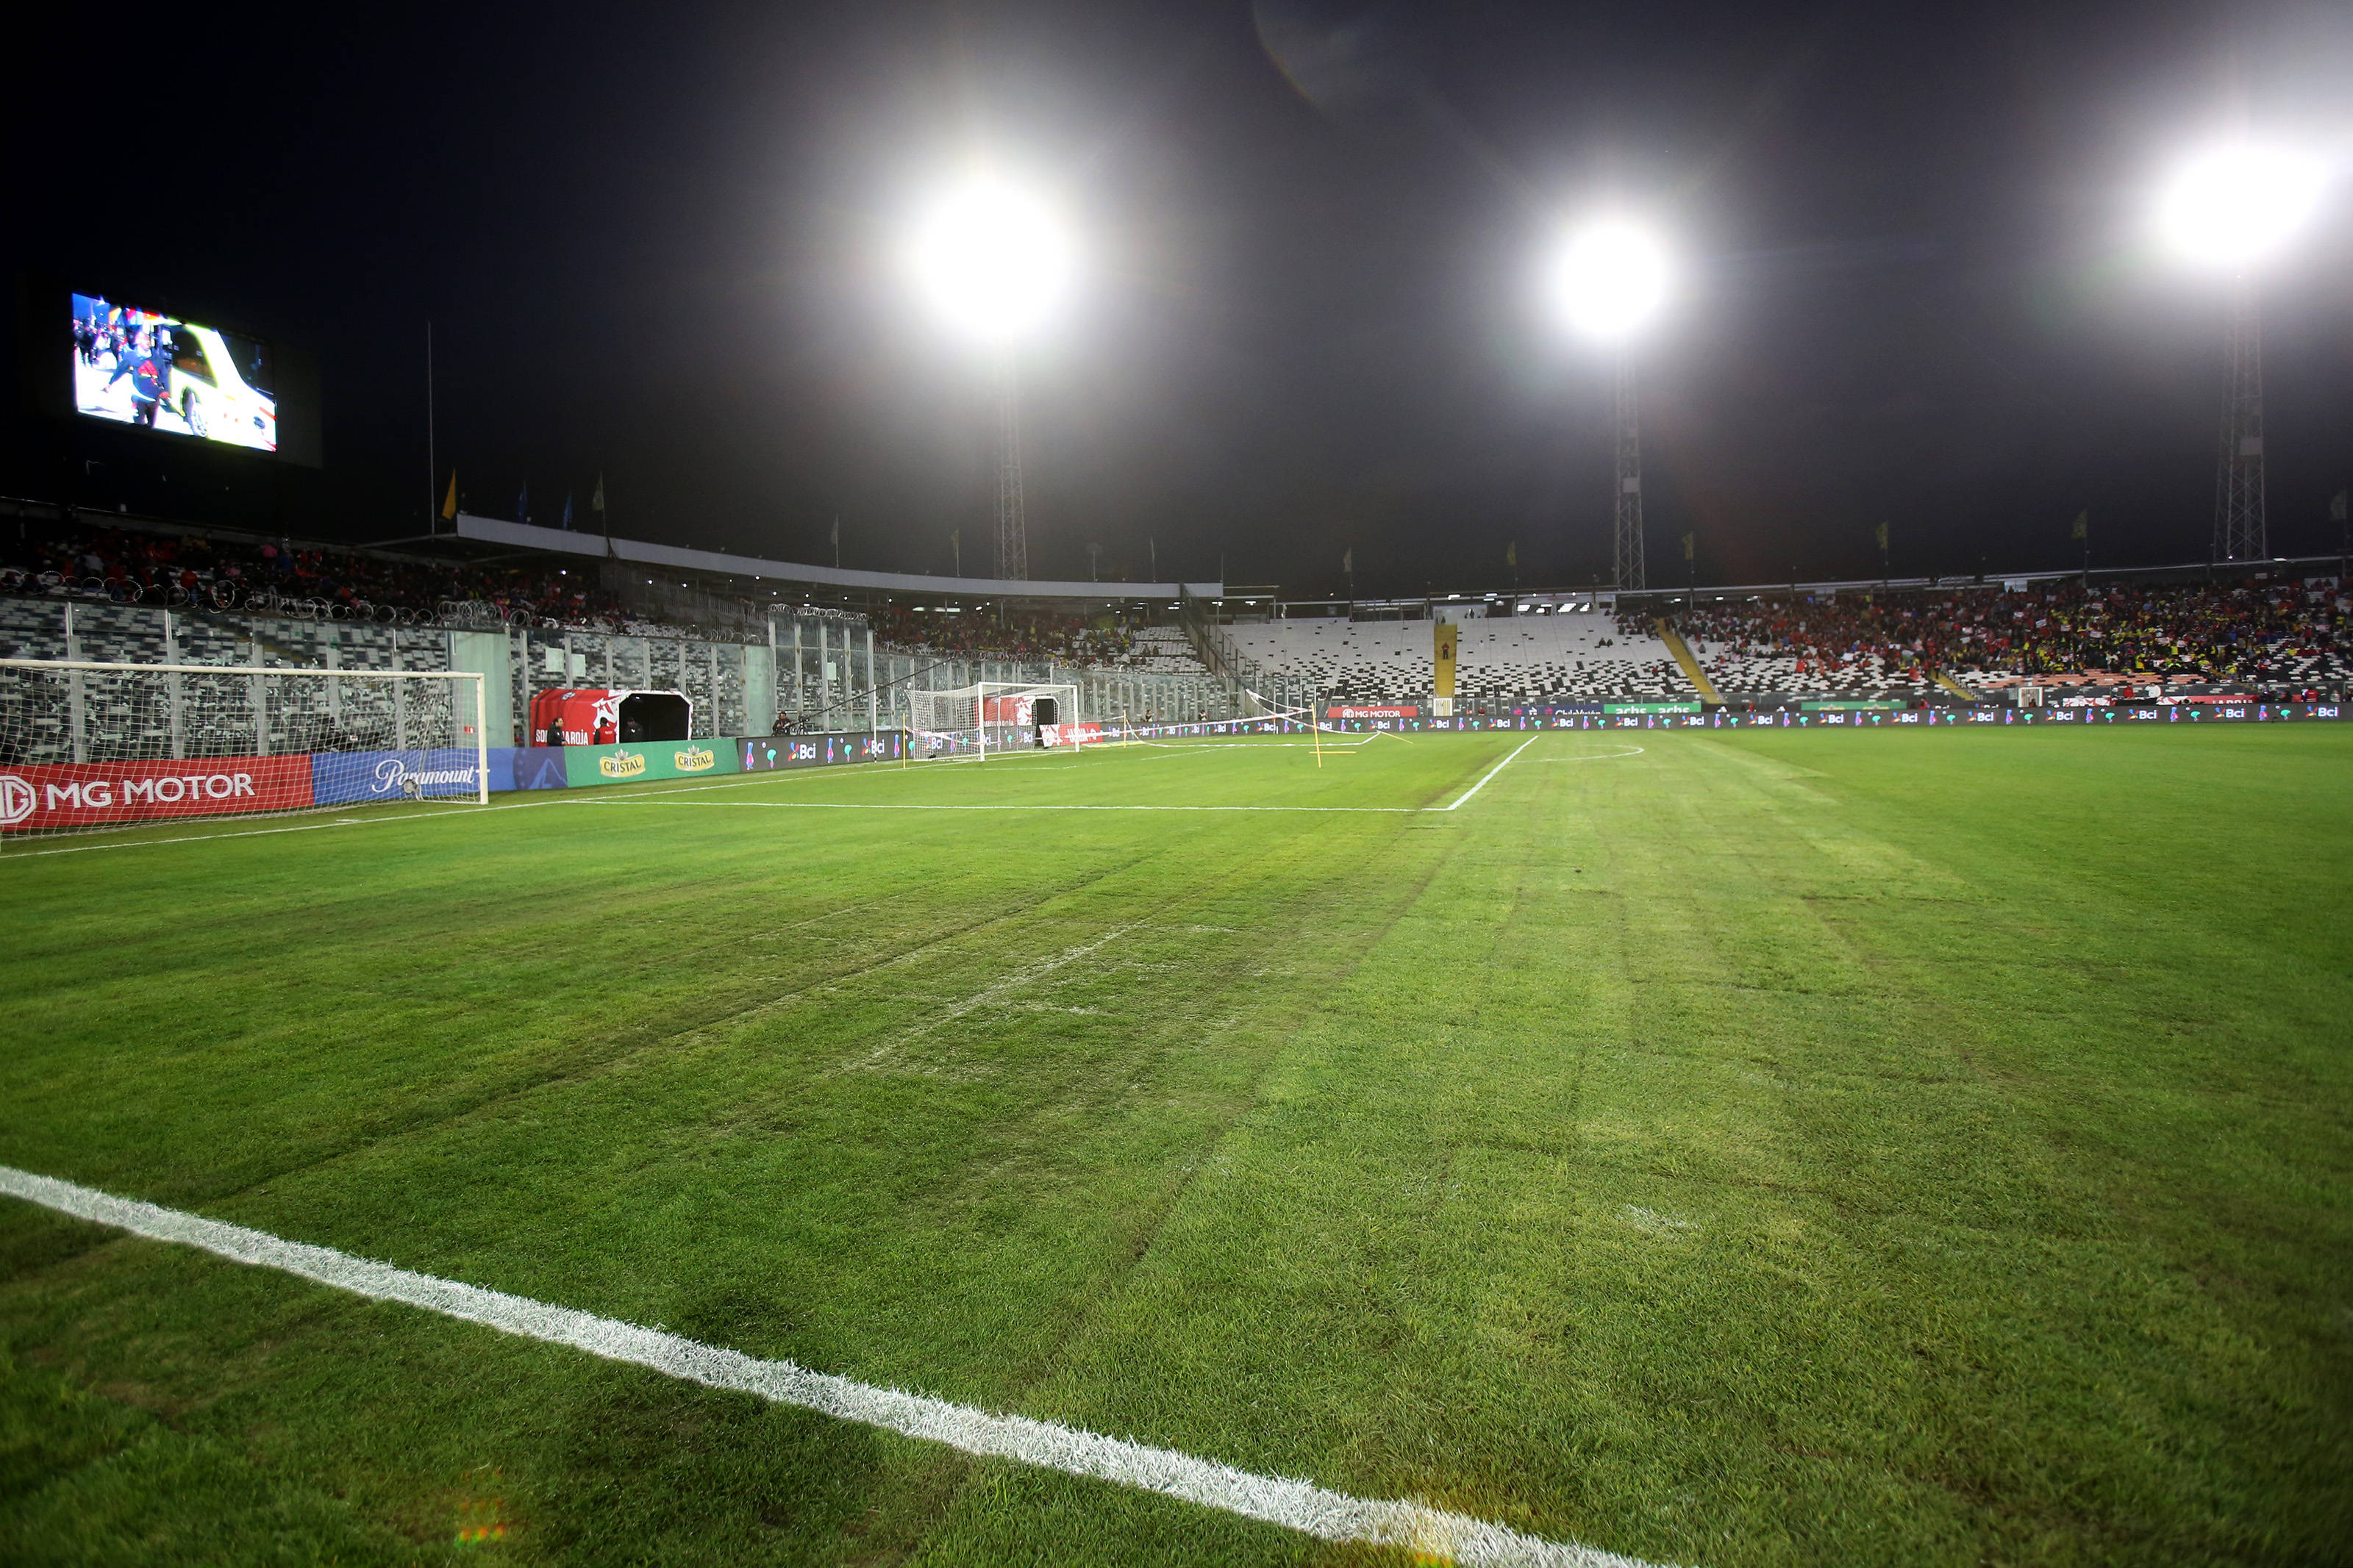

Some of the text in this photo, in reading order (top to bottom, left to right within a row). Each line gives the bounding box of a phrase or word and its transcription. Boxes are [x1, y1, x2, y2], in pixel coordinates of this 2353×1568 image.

[1370, 710, 1401, 718] MOTOR
[2056, 711, 2074, 720] Bci
[2139, 709, 2157, 720] Bci
[2225, 708, 2245, 718] Bci
[2318, 706, 2339, 717] Bci
[1624, 717, 1638, 727] Bci
[1689, 716, 1704, 726] Bci
[1757, 715, 1774, 725] Bci
[1828, 714, 1844, 724] Bci
[1902, 713, 1918, 723] Bci
[1977, 712, 1994, 722] Bci
[1263, 723, 1275, 731] Bci
[1319, 721, 1332, 730] Bci
[1377, 720, 1390, 729] Bci
[1436, 720, 1449, 729] Bci
[1496, 719, 1510, 728] Bci
[1559, 717, 1574, 728] Bci
[799, 742, 816, 759] Bci
[871, 739, 885, 754] Bci
[604, 759, 642, 773] CRISTAL
[678, 756, 711, 767] CRISTAL
[46, 781, 113, 810] MG
[124, 773, 255, 805] MOTOR
